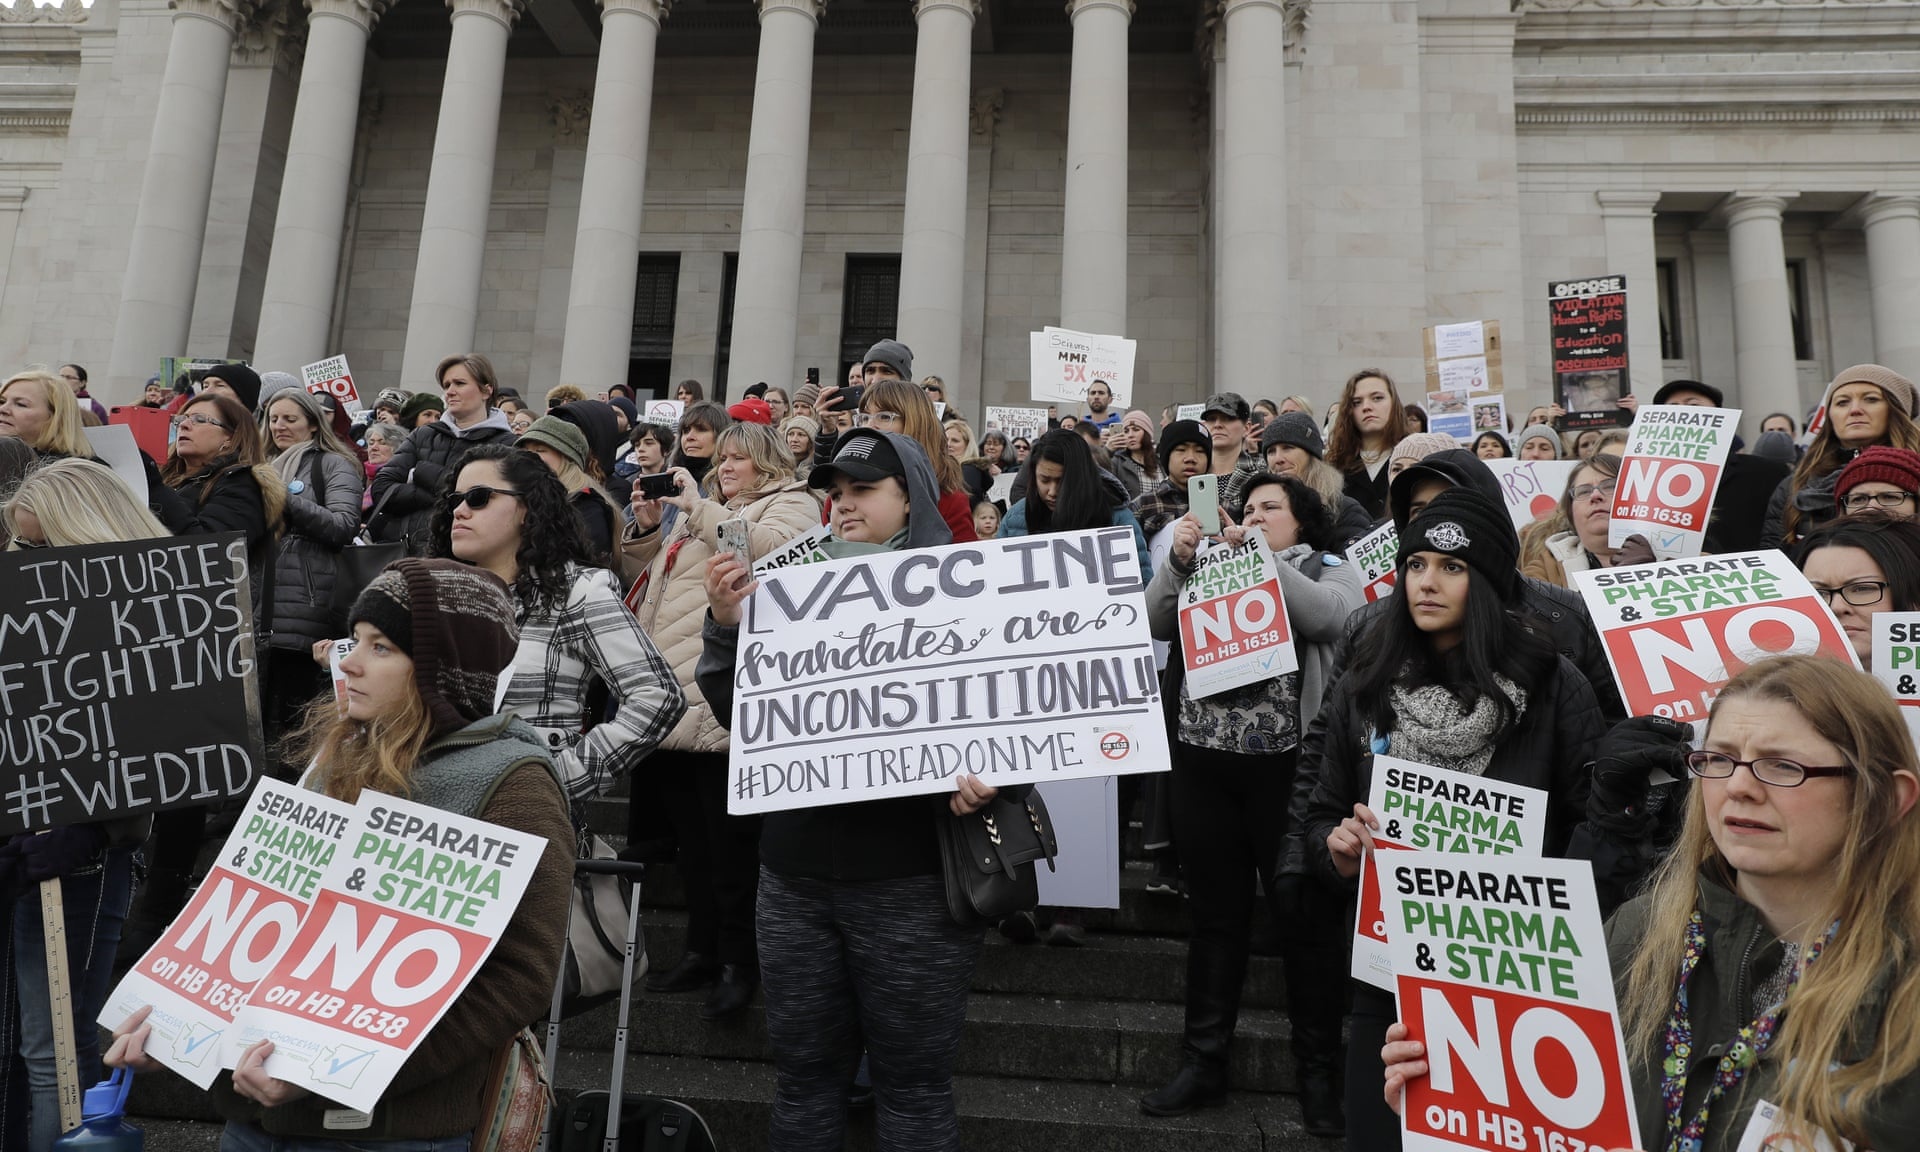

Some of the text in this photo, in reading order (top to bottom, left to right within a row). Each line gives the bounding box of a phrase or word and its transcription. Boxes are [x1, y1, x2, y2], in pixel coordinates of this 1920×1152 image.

[1555, 278, 1620, 296] OPPOSE
[1555, 294, 1624, 311] VIOLATION
[1552, 307, 1623, 326] Human Rights
[1058, 351, 1087, 363] MMR
[1555, 333, 1622, 348] Education
[305, 359, 341, 373] SEPARATE
[306, 364, 343, 379] PHARMA
[317, 370, 343, 382] STATE
[1063, 364, 1119, 382] 5X MORE
[1637, 425, 1718, 445] PHARMA
[1641, 411, 1725, 428] SEPARATE
[1634, 441, 1711, 461] & STATE
[1499, 462, 1543, 506] IRST
[1621, 460, 1706, 508] NO
[1616, 504, 1693, 527] on HB 1638
[755, 536, 818, 572] ARATE
[1191, 537, 1259, 573] EPARATE
[1355, 527, 1398, 558] SEPAR
[19, 541, 249, 604] INJURIES
[764, 530, 1140, 622] VACCINE
[1185, 552, 1265, 591] PHARMA
[1188, 568, 1265, 604] & STATE
[1368, 569, 1378, 580] &
[1594, 556, 1767, 587] SEPARATE
[1602, 568, 1781, 605] PHARMA
[1190, 589, 1276, 650] NO
[1620, 583, 1783, 622] & STATE
[0, 607, 76, 655] MY
[737, 605, 1115, 688] mandates are
[1195, 630, 1280, 665] on HB 1638
[1629, 606, 1820, 695] NO
[0, 633, 254, 716] FIGHTING
[1896, 674, 1917, 694] &
[1652, 698, 1696, 719] on
[5, 744, 253, 829] #WEDID
[1385, 768, 1525, 818] SEPARATE
[257, 790, 349, 840] SEPARATE
[1384, 790, 1523, 847] PHARMA
[1386, 819, 1402, 839] &
[242, 815, 337, 867] PHARMA
[366, 806, 519, 867] SEPARATE
[231, 846, 322, 900] & STATE
[352, 832, 500, 900] PHARMA
[345, 867, 486, 928] & STATE
[1395, 866, 1571, 910] SEPARATE
[174, 877, 300, 983] NO
[1372, 920, 1386, 937] o
[1401, 899, 1583, 957] PHARMA
[290, 901, 461, 1008] NO
[1415, 942, 1579, 1000] & STATE
[151, 956, 175, 979] on
[175, 960, 205, 992] HB
[203, 972, 250, 1016] 1638
[264, 984, 409, 1039] on HB 1638
[1420, 986, 1606, 1129] NO
[1425, 1104, 1604, 1152] on HB 16
